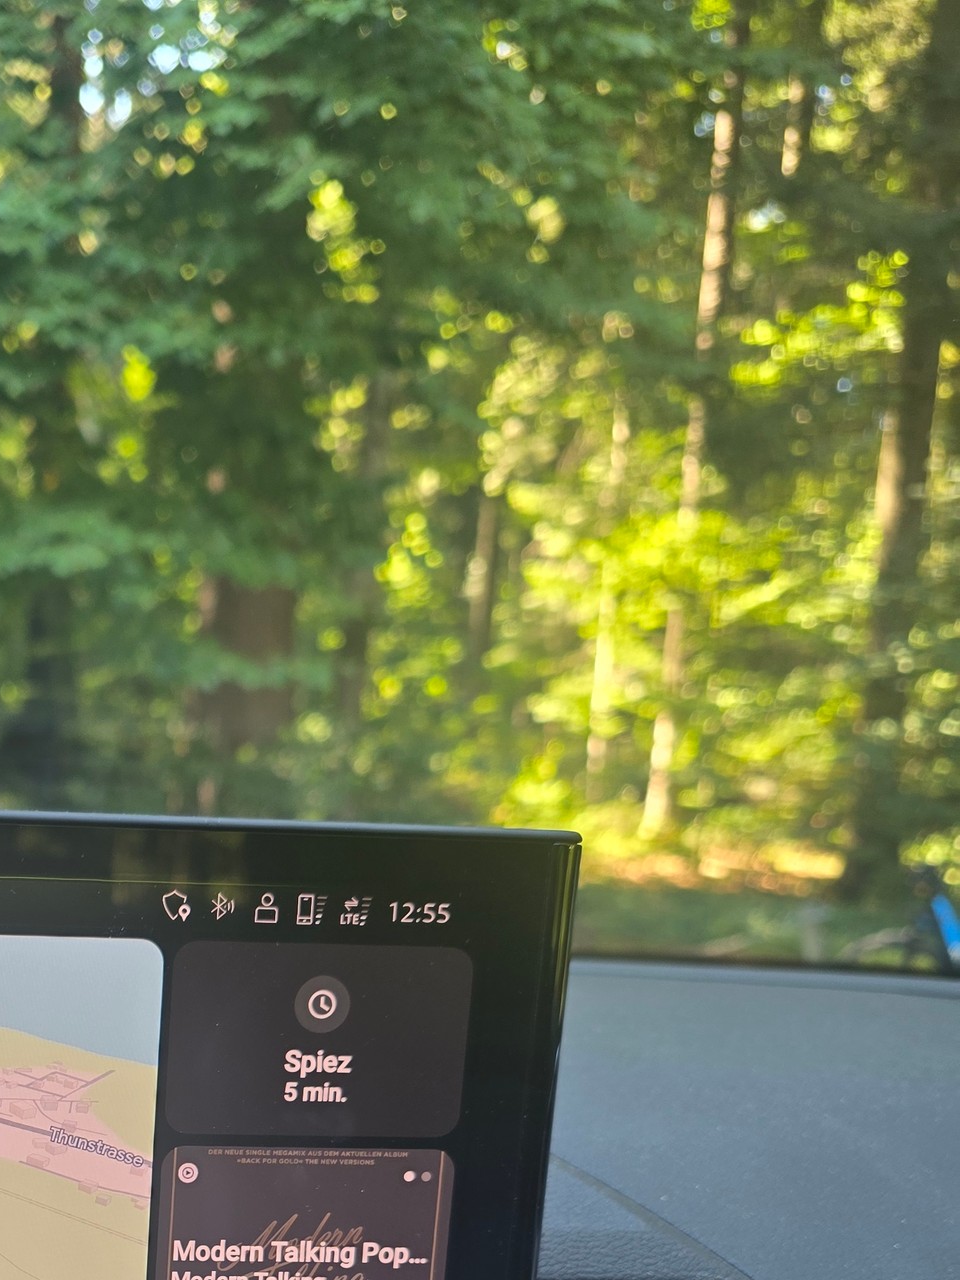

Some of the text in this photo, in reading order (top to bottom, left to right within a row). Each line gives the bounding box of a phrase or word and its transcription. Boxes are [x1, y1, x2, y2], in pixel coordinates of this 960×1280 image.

[340, 913, 360, 926] LTE
[389, 902, 452, 924] 12:55
[284, 1049, 353, 1078] Spiez
[284, 1081, 348, 1103] 5 min.
[49, 1126, 144, 1167] Thunstrasse
[208, 1148, 223, 1156] DER
[172, 1240, 264, 1262] Modern
[271, 1241, 356, 1268] Talking
